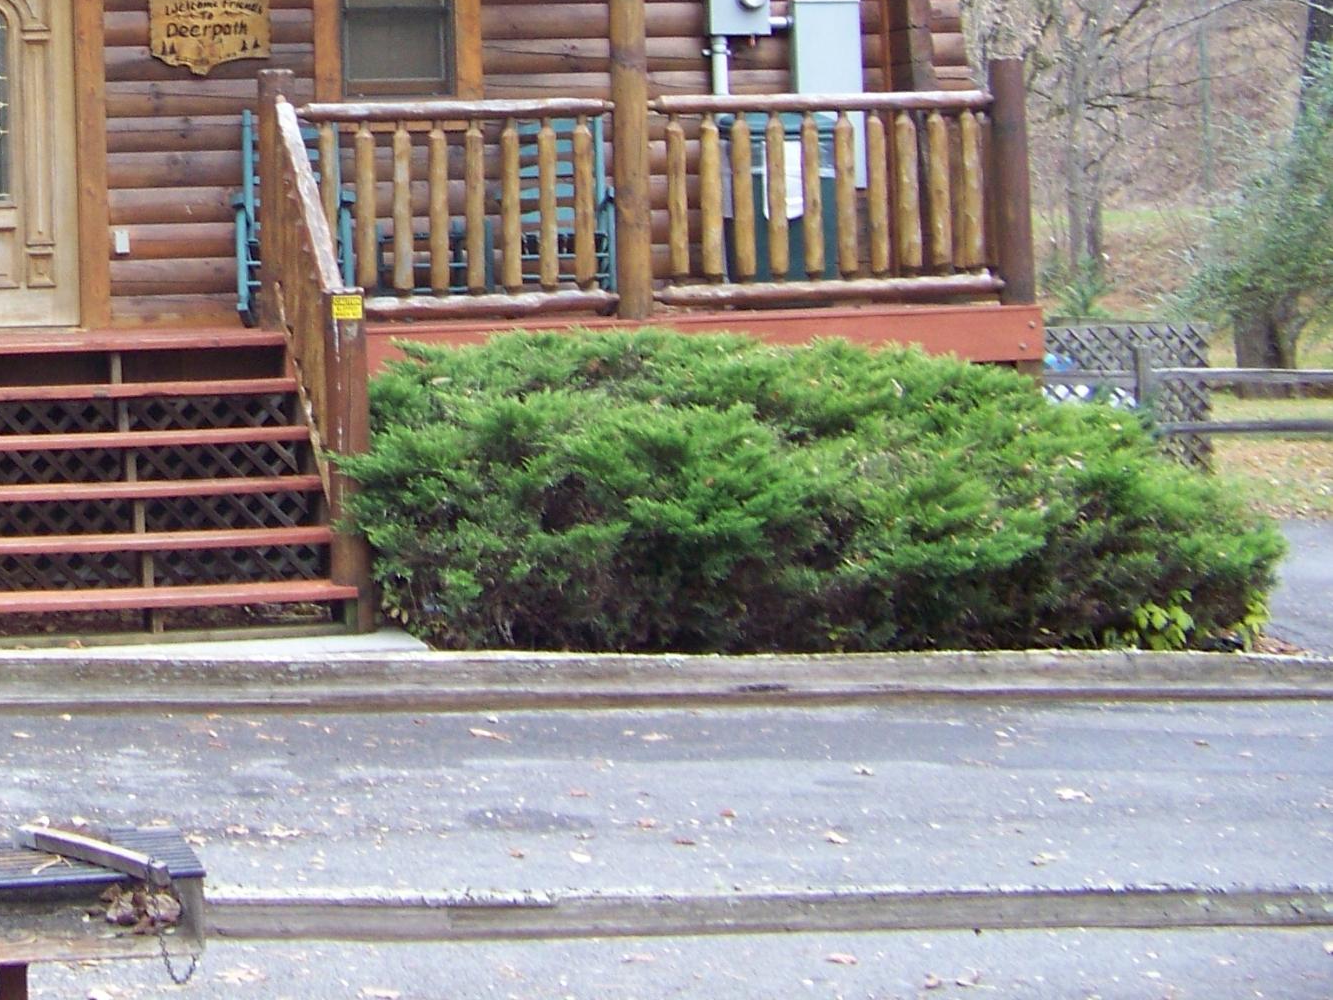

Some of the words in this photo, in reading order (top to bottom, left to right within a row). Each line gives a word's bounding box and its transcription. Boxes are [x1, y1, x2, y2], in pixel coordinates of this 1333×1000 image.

[165, 0, 218, 16] Welcome
[201, 11, 214, 20] To
[166, 20, 248, 40] Deerpath
